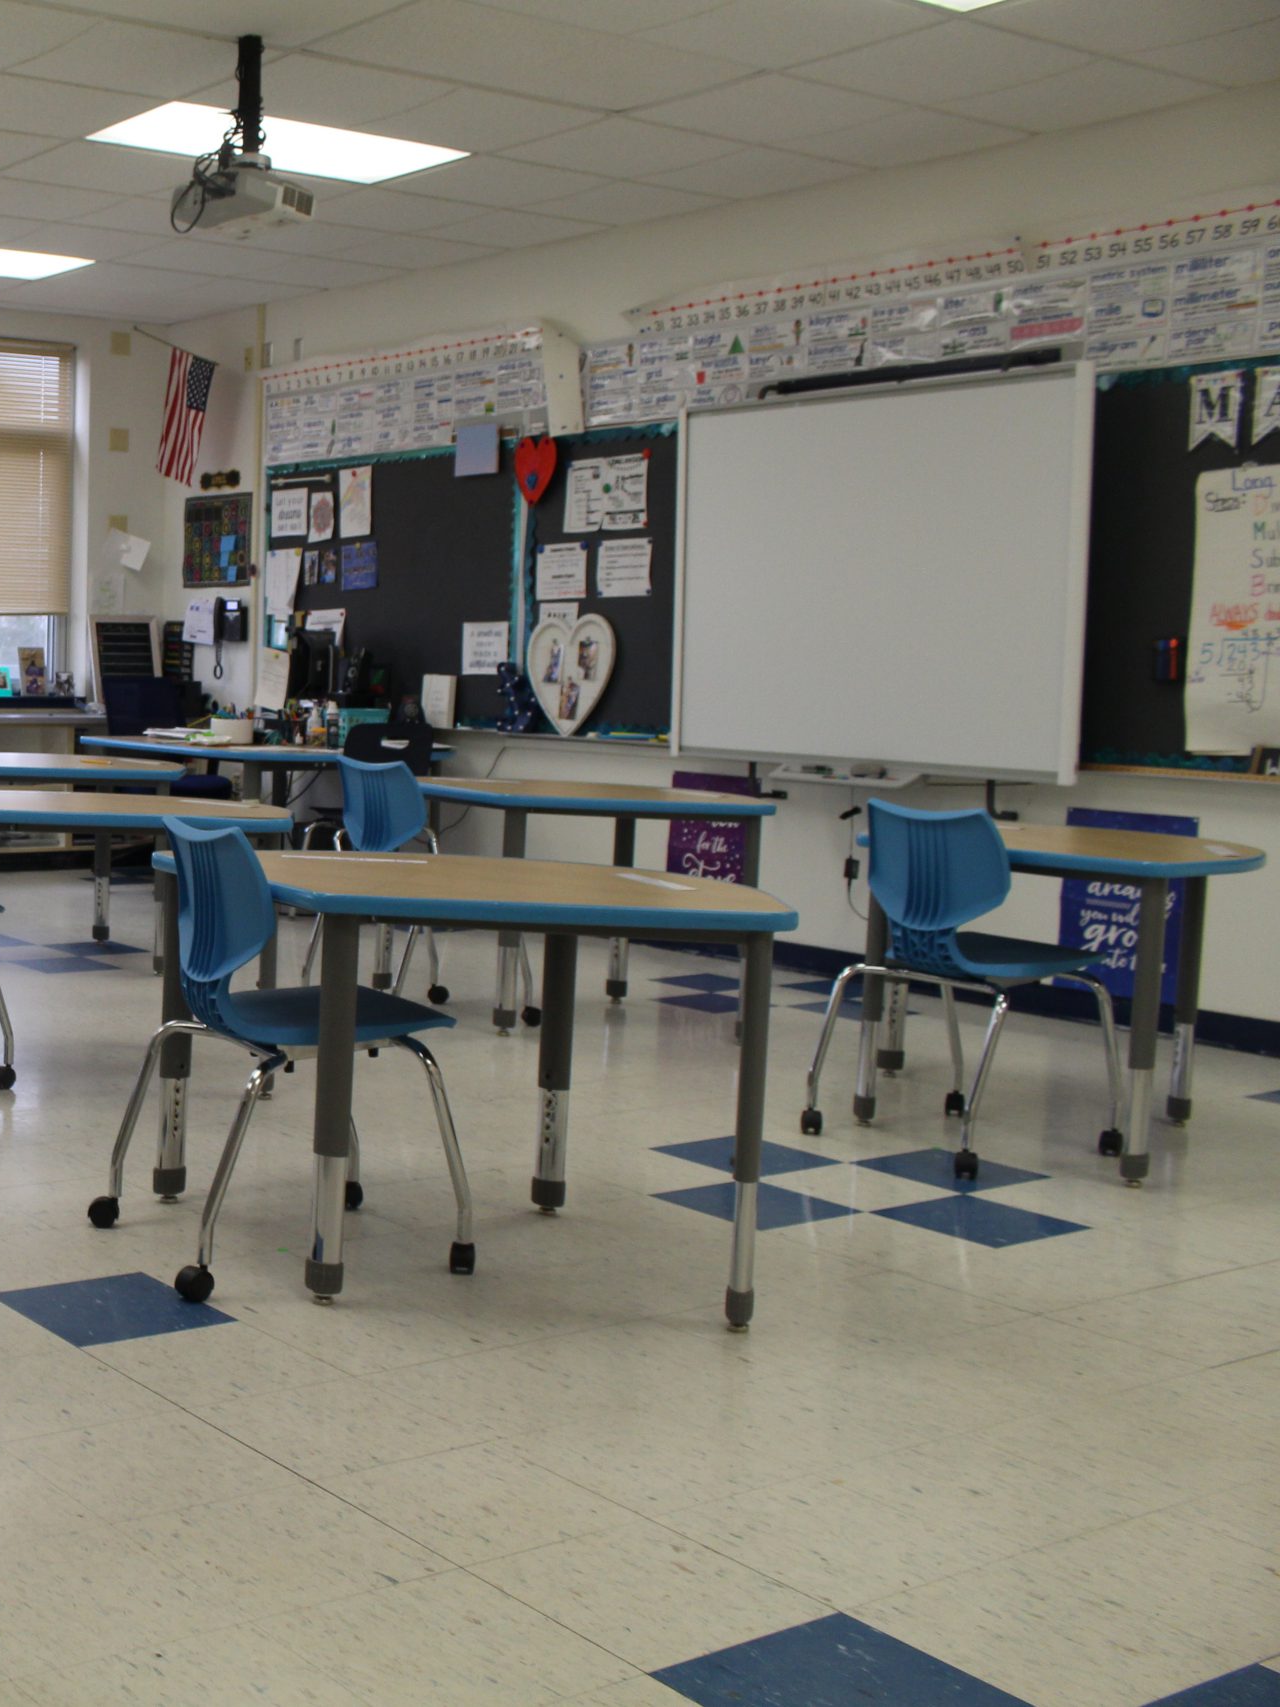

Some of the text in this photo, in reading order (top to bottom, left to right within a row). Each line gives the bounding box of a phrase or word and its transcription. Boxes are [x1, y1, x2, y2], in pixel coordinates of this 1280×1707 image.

[1037, 255, 1050, 269] 51
[1059, 251, 1077, 266] 52
[1083, 247, 1102, 261] 53
[1108, 243, 1127, 258] 54
[1133, 237, 1153, 253] 55
[1158, 232, 1180, 250] 56
[1185, 228, 1206, 245] 57
[1212, 223, 1233, 240] 58
[1240, 218, 1261, 235] 59
[734, 304, 750, 318] 36
[754, 301, 768, 315] 37
[846, 286, 860, 299] 42
[866, 283, 881, 295] 43
[885, 280, 901, 293] 44
[905, 276, 920, 290] 45
[924, 273, 941, 286] 46
[945, 269, 961, 283] 47
[965, 267, 983, 279] 48
[986, 263, 1001, 275] 49
[1007, 260, 1024, 274] 50
